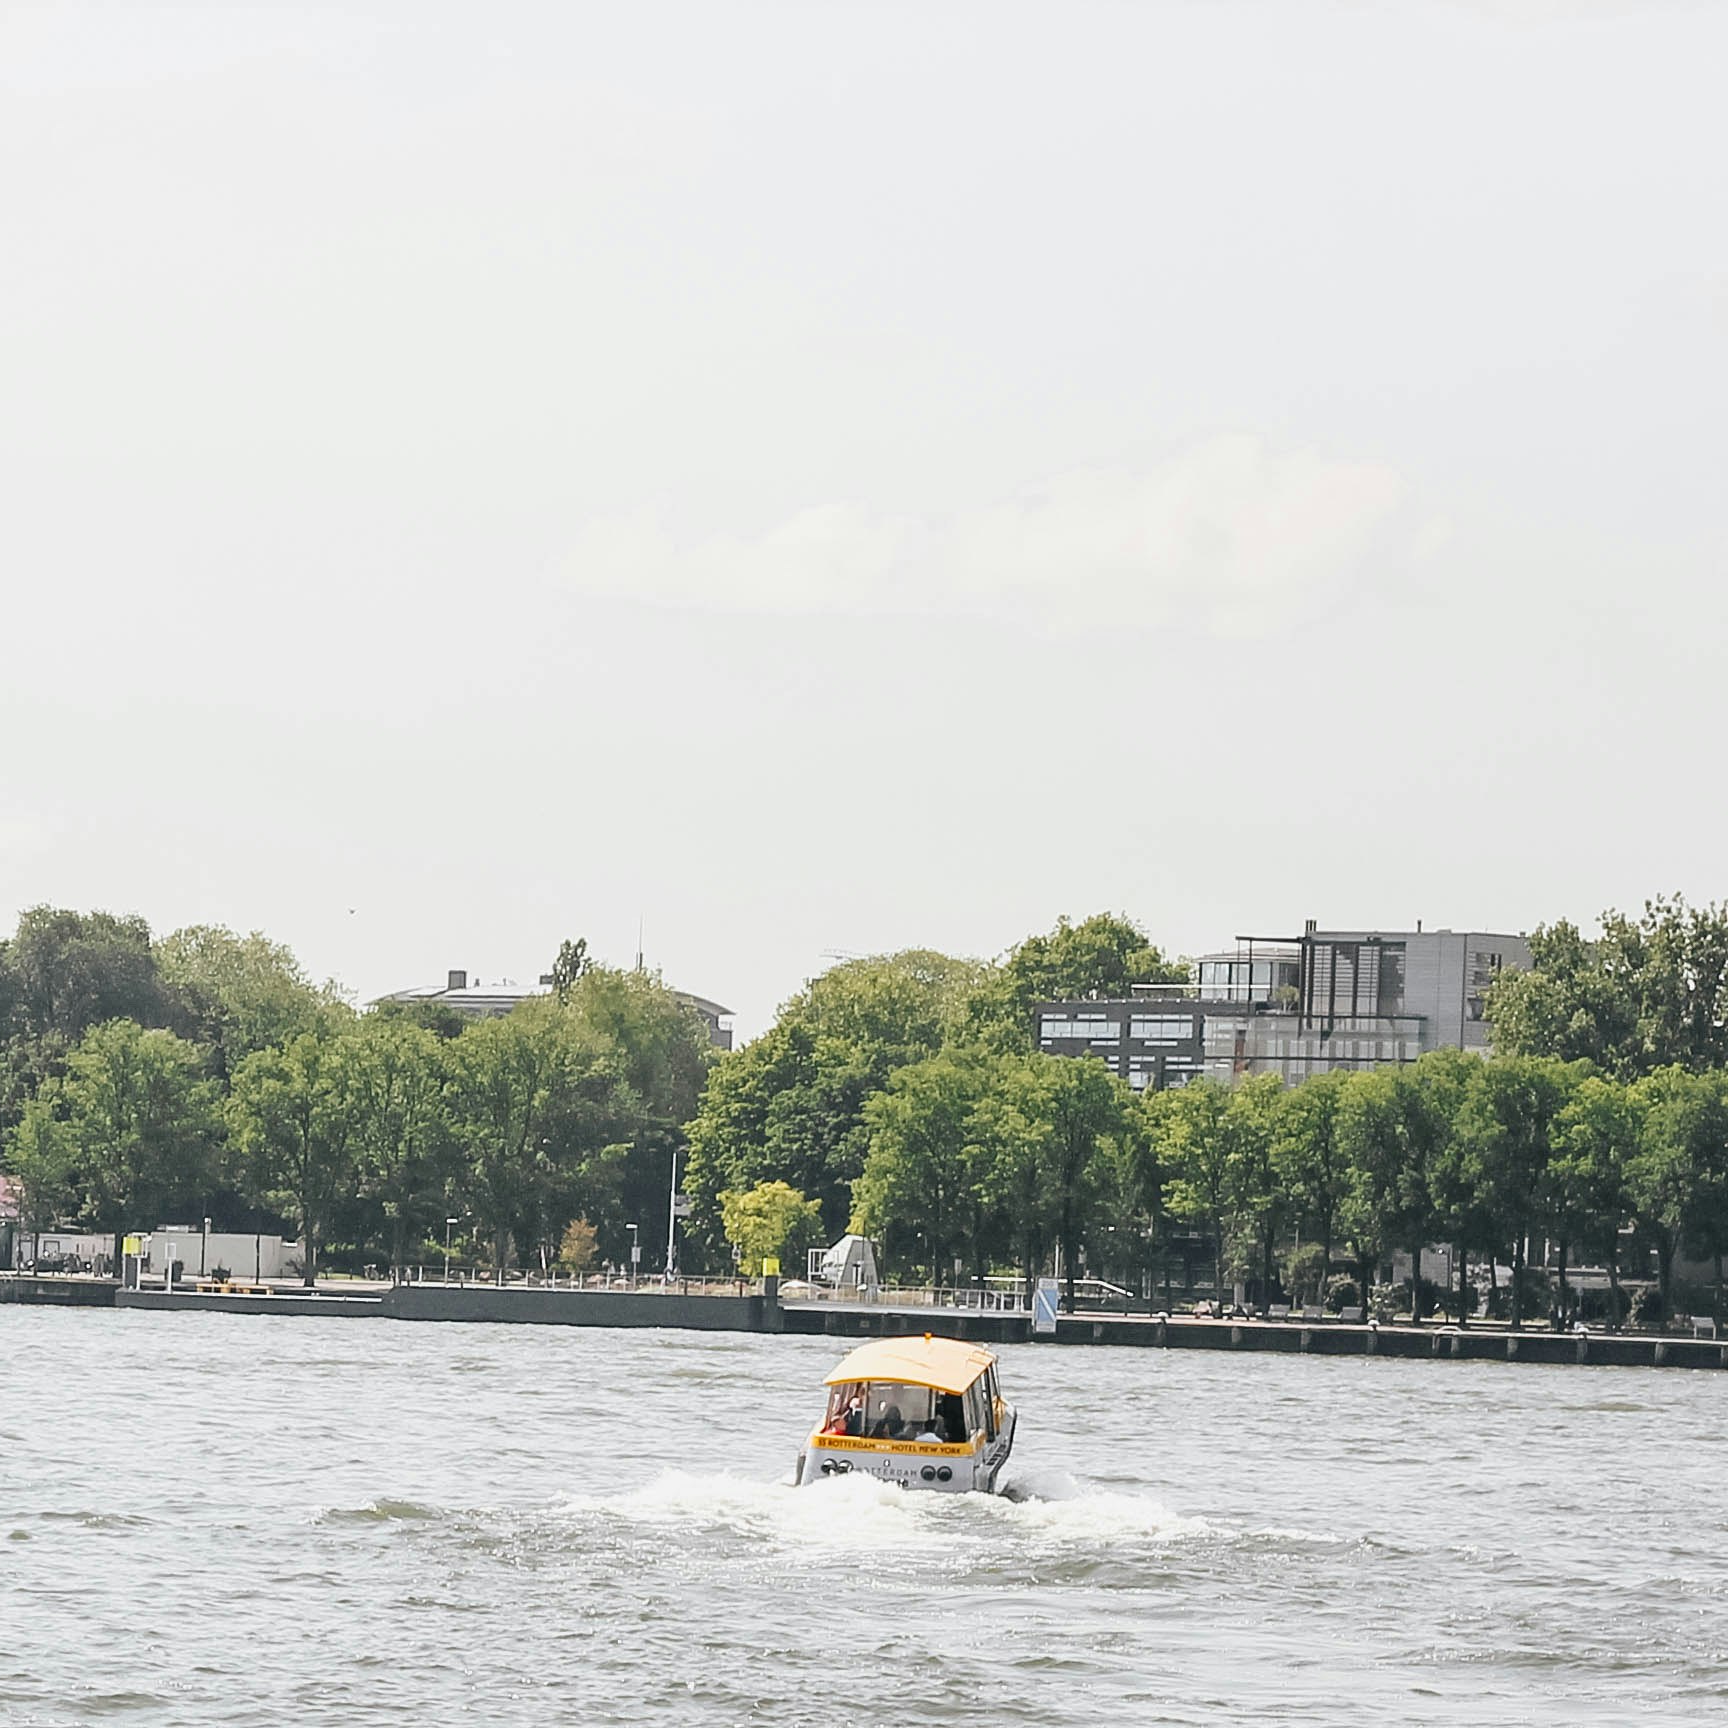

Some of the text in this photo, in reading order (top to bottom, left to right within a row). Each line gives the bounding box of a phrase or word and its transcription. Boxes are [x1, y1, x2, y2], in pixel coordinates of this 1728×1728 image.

[827, 1439, 876, 1450] ROTTERDAM
[891, 1444, 917, 1452] HOTEL
[940, 1447, 961, 1455] YORK
